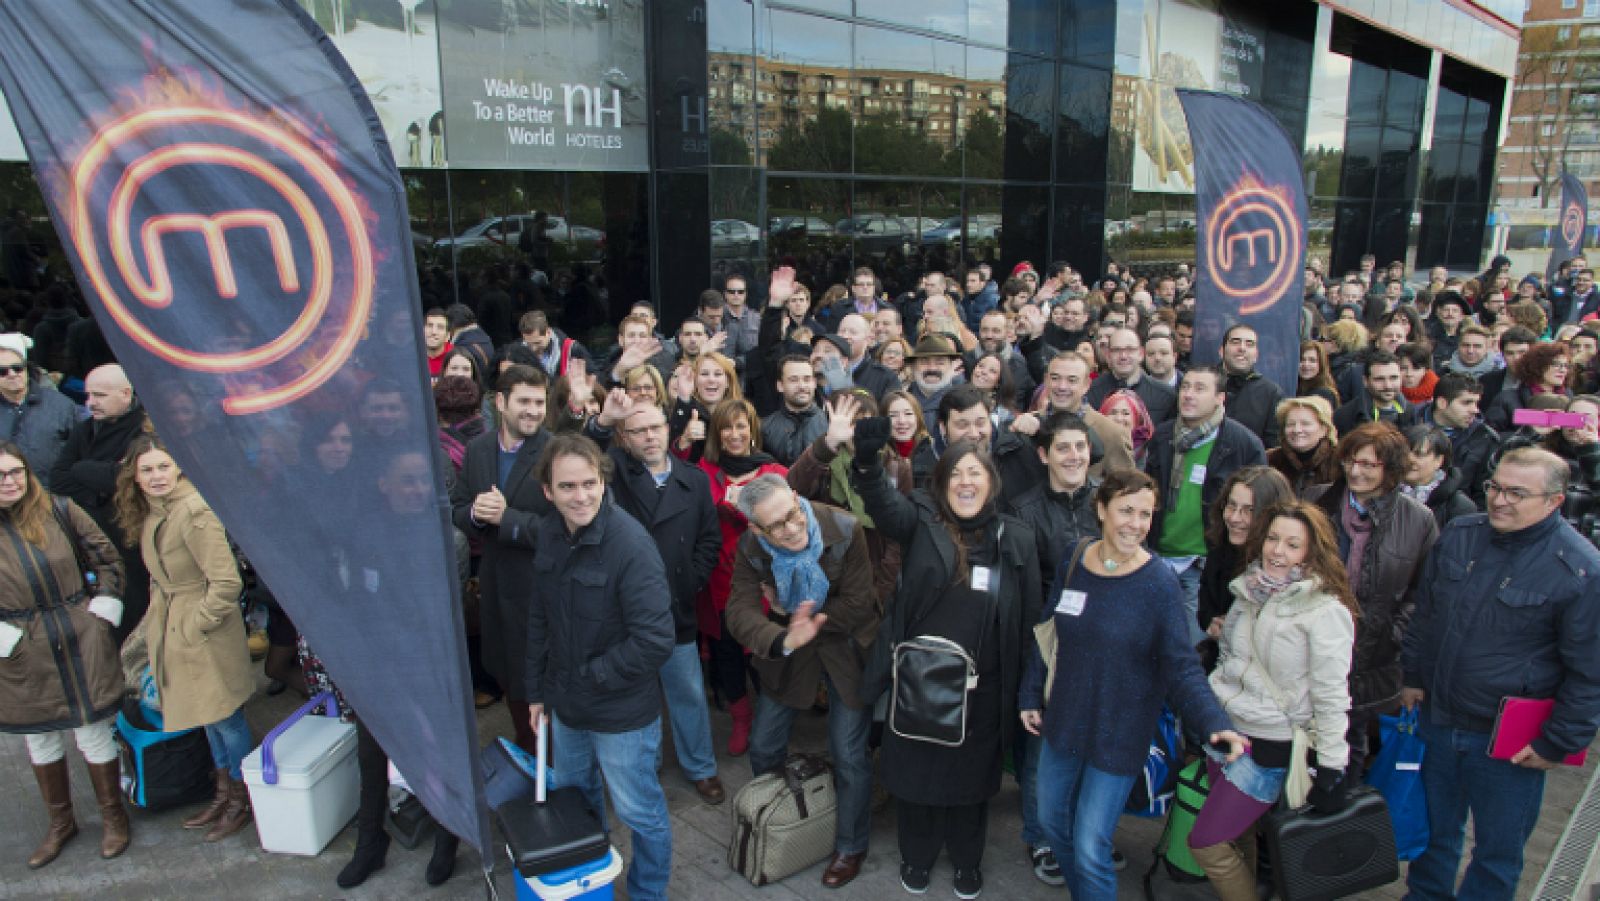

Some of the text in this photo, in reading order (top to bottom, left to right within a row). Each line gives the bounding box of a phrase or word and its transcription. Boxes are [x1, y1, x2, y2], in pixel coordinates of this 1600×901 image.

[484, 78, 553, 105] Wake Up
[473, 101, 554, 123] To a Better
[507, 126, 555, 145] World
[566, 133, 622, 149] HOTELES
